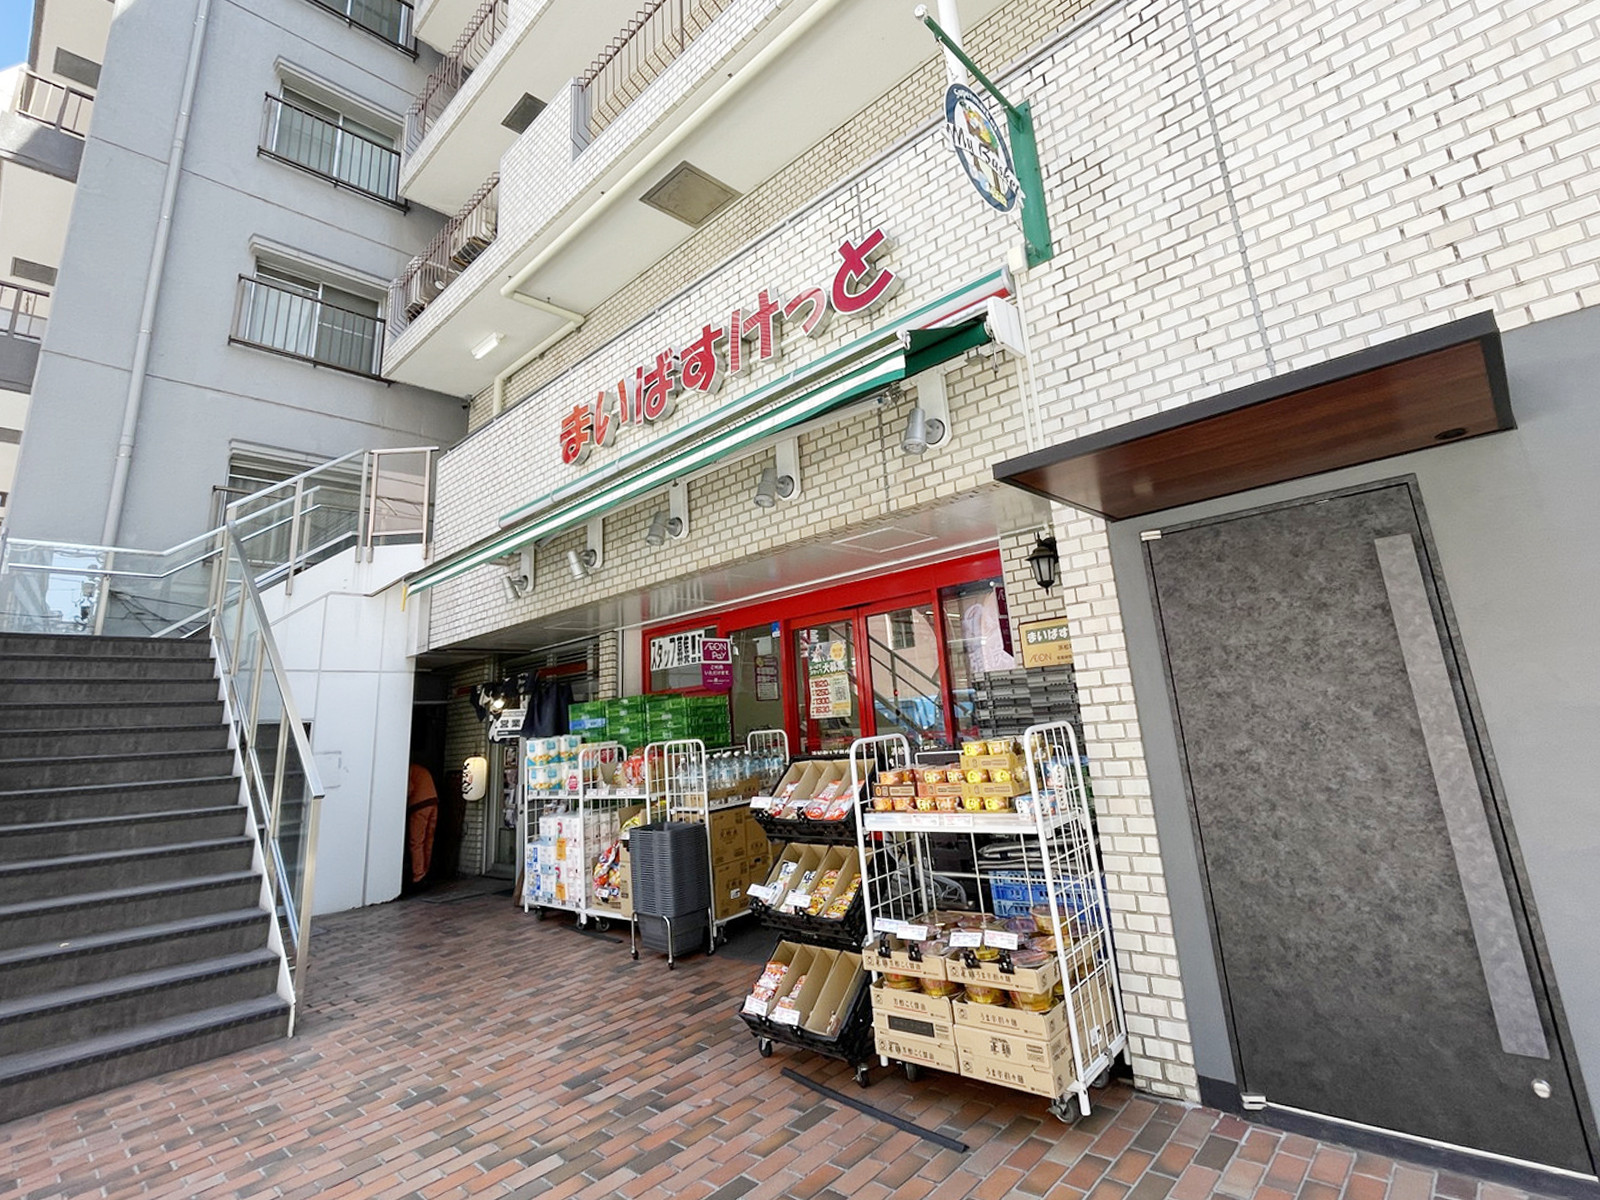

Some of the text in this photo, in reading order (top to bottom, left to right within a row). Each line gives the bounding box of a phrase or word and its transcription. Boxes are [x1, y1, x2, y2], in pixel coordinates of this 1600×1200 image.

[946, 123, 1019, 195] My Basket
[559, 228, 899, 466] まいばすけっと
[1027, 627, 1069, 642] まいばす
[704, 642, 727, 651] AEON
[1029, 653, 1052, 663] AEON
